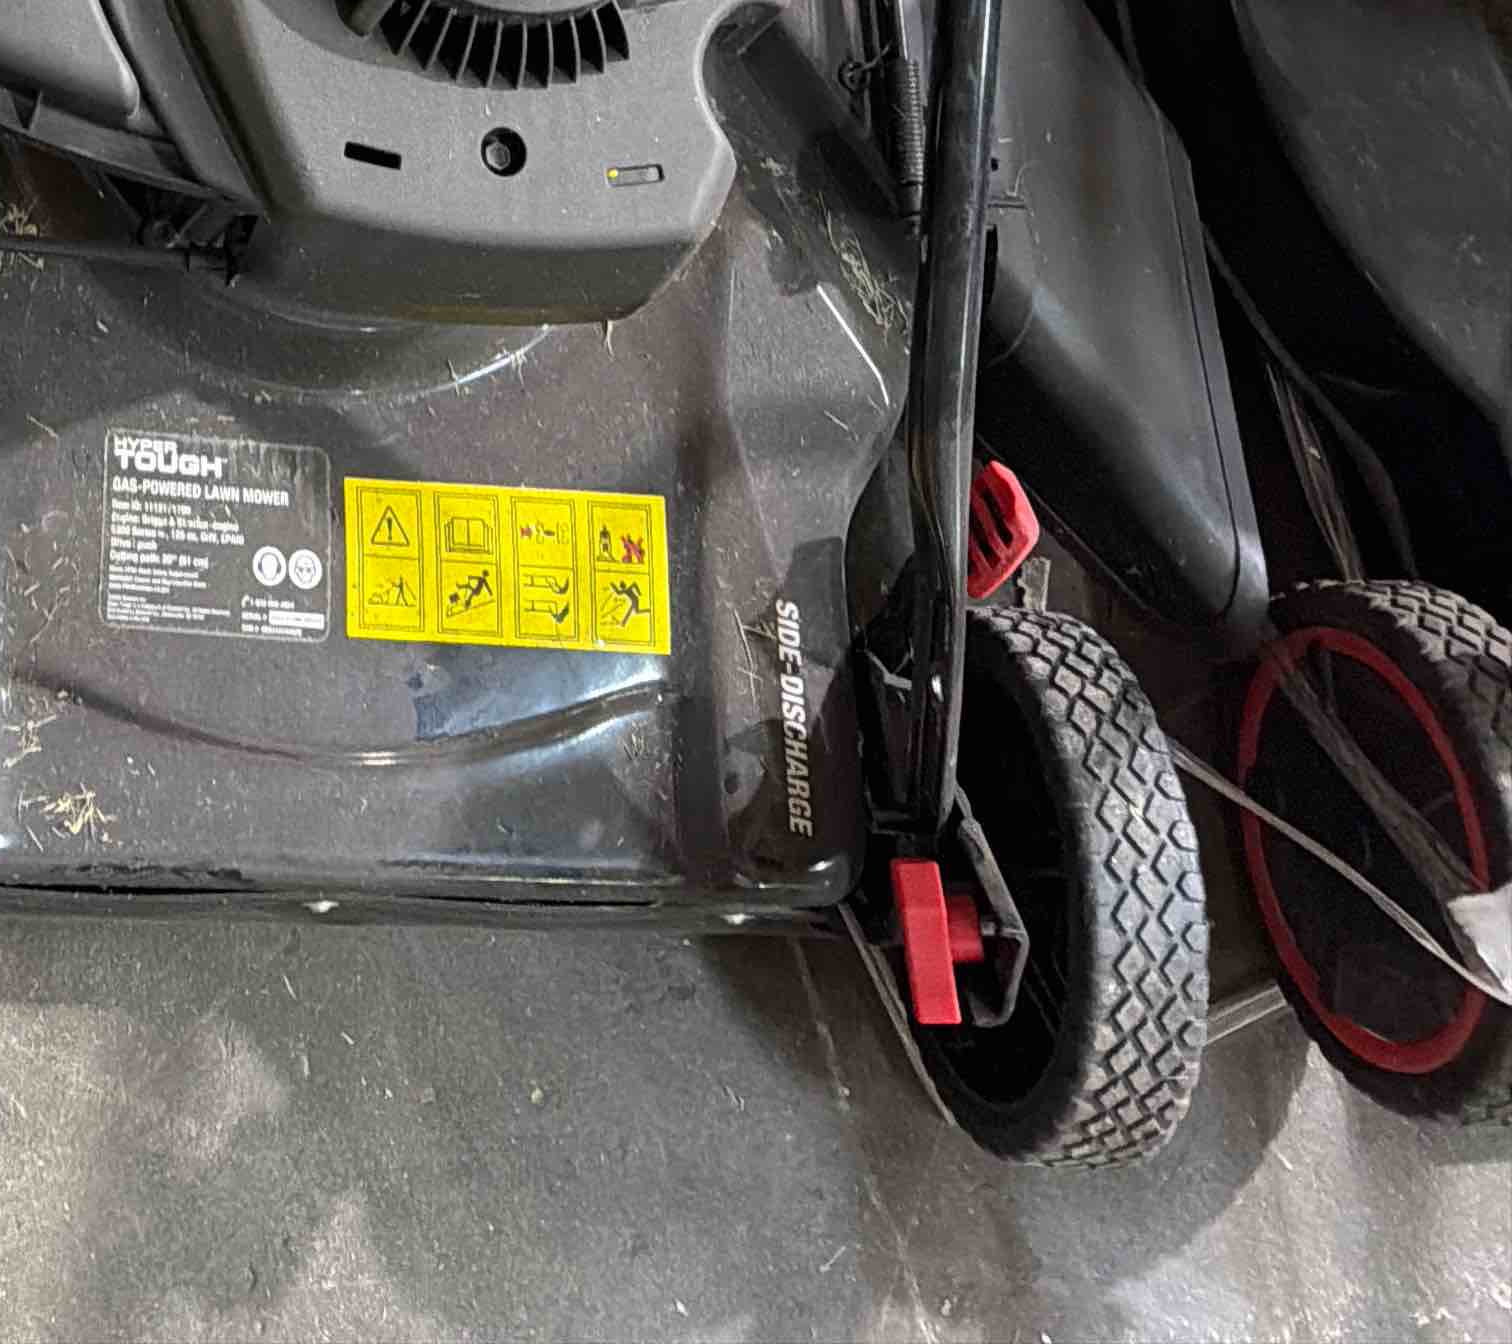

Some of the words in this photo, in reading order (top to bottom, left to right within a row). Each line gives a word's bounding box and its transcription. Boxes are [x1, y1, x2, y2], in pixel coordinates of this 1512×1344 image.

[113, 436, 178, 454] HYPER
[114, 449, 222, 478] TOUGH
[113, 476, 201, 499] GAS-POWERED
[205, 485, 239, 502] LAWN
[243, 488, 289, 506] MOWER
[776, 599, 813, 838] SIDE-DISCHARGE
